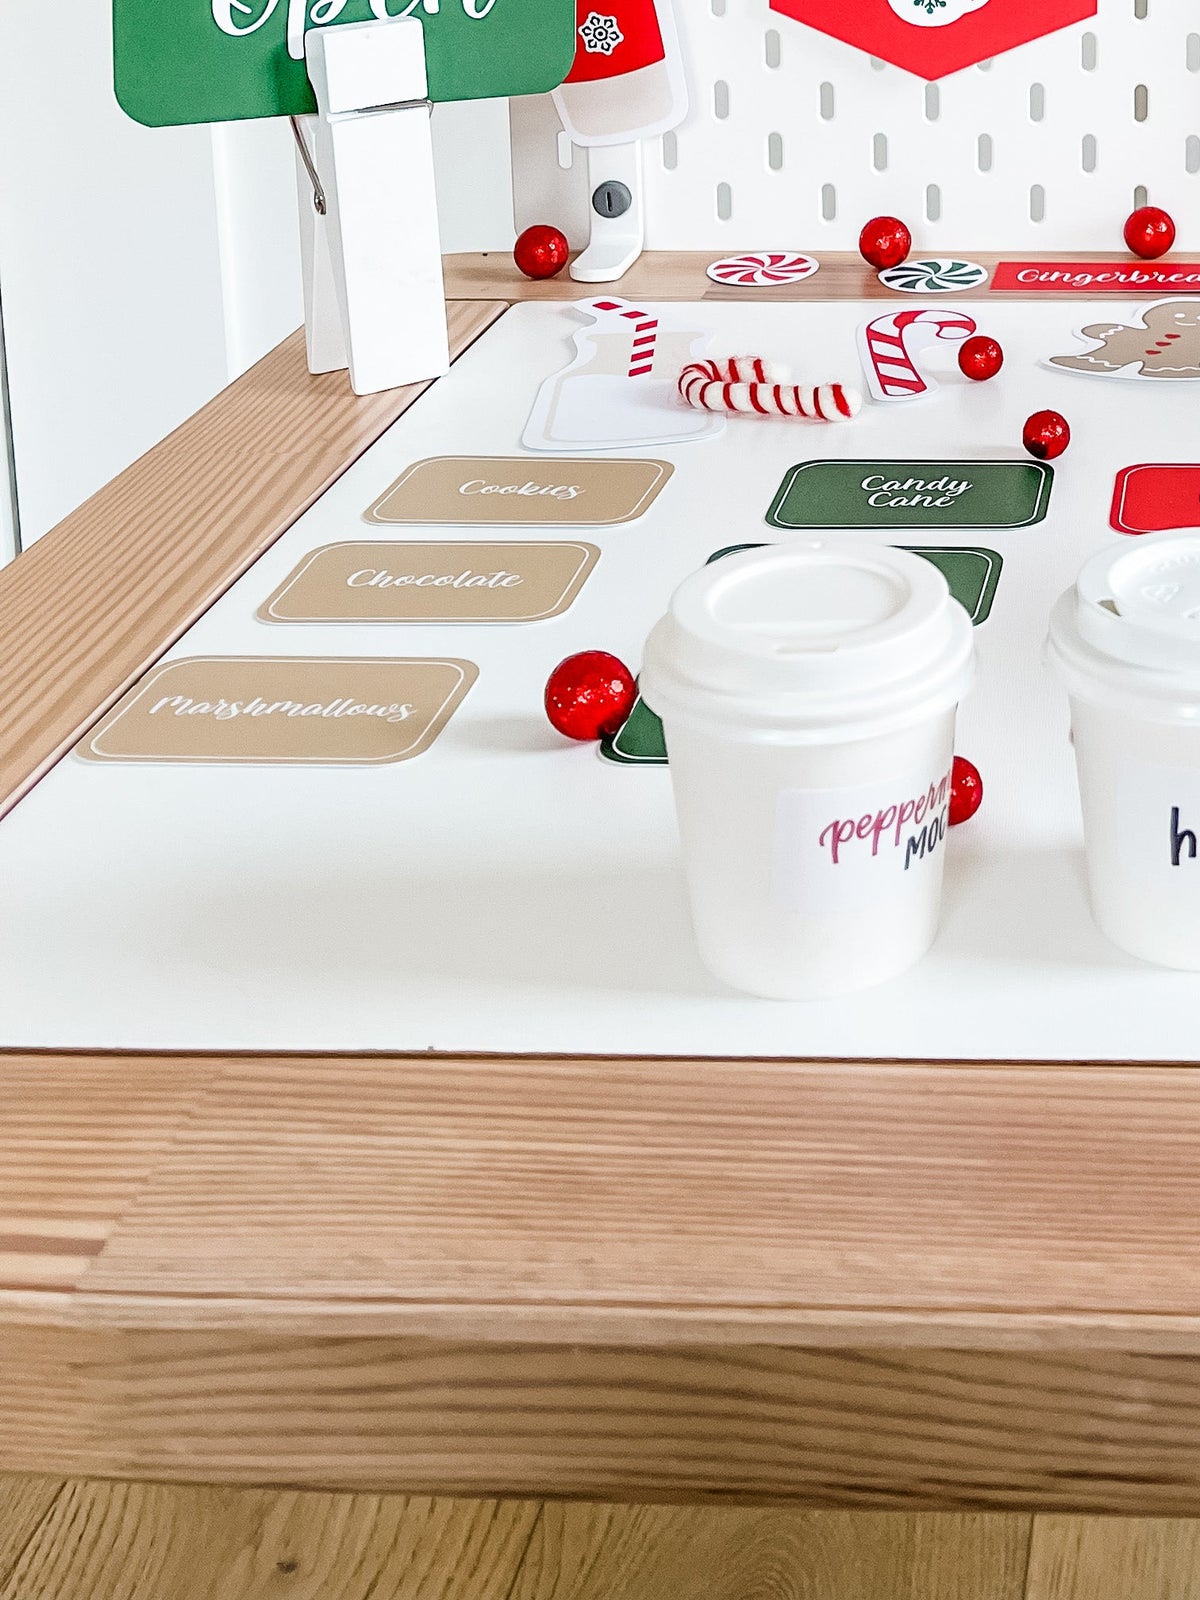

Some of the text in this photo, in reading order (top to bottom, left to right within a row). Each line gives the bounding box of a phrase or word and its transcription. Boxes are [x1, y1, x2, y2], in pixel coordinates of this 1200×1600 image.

[458, 478, 583, 501] Cookies
[861, 475, 974, 497] Candy
[867, 490, 956, 508] Cane
[345, 567, 525, 590] Chocolate
[148, 693, 418, 723] Marshmallows
